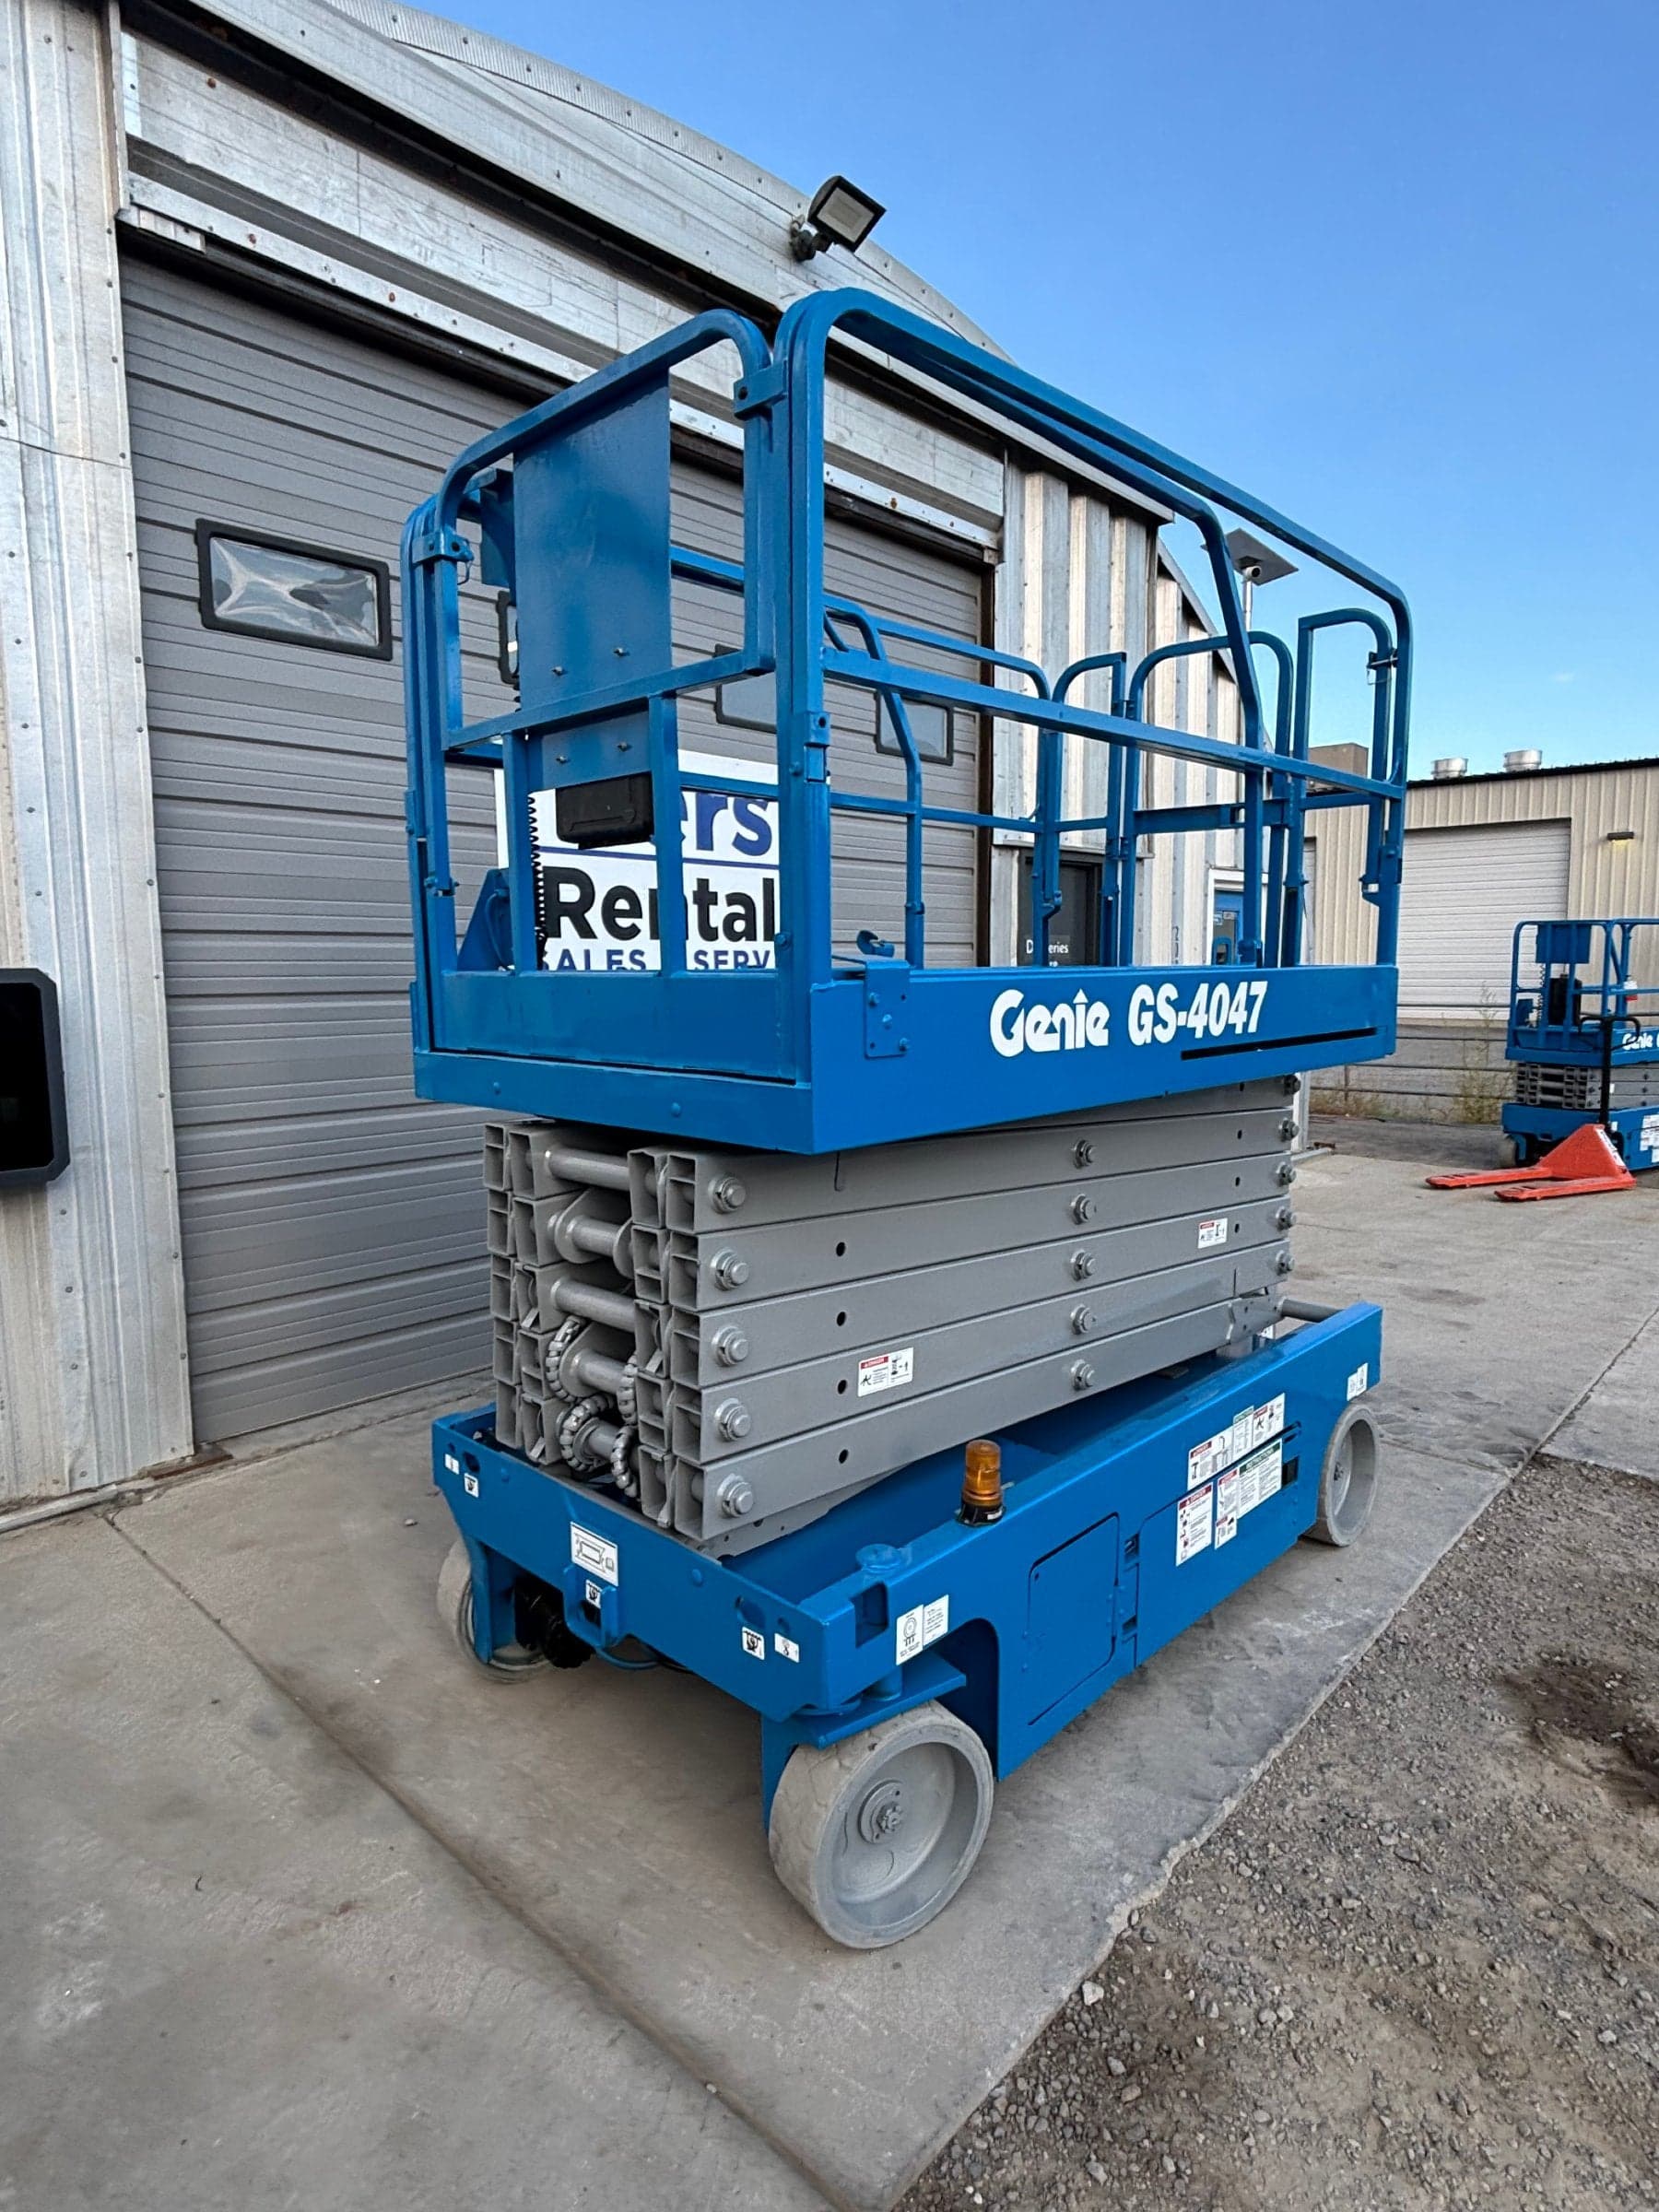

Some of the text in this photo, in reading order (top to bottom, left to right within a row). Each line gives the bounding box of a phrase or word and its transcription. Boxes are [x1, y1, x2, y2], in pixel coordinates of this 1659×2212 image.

[1026, 939, 1069, 954] Deries
[543, 948, 647, 971] ALES
[989, 981, 1268, 1057] Genie GS-4047
